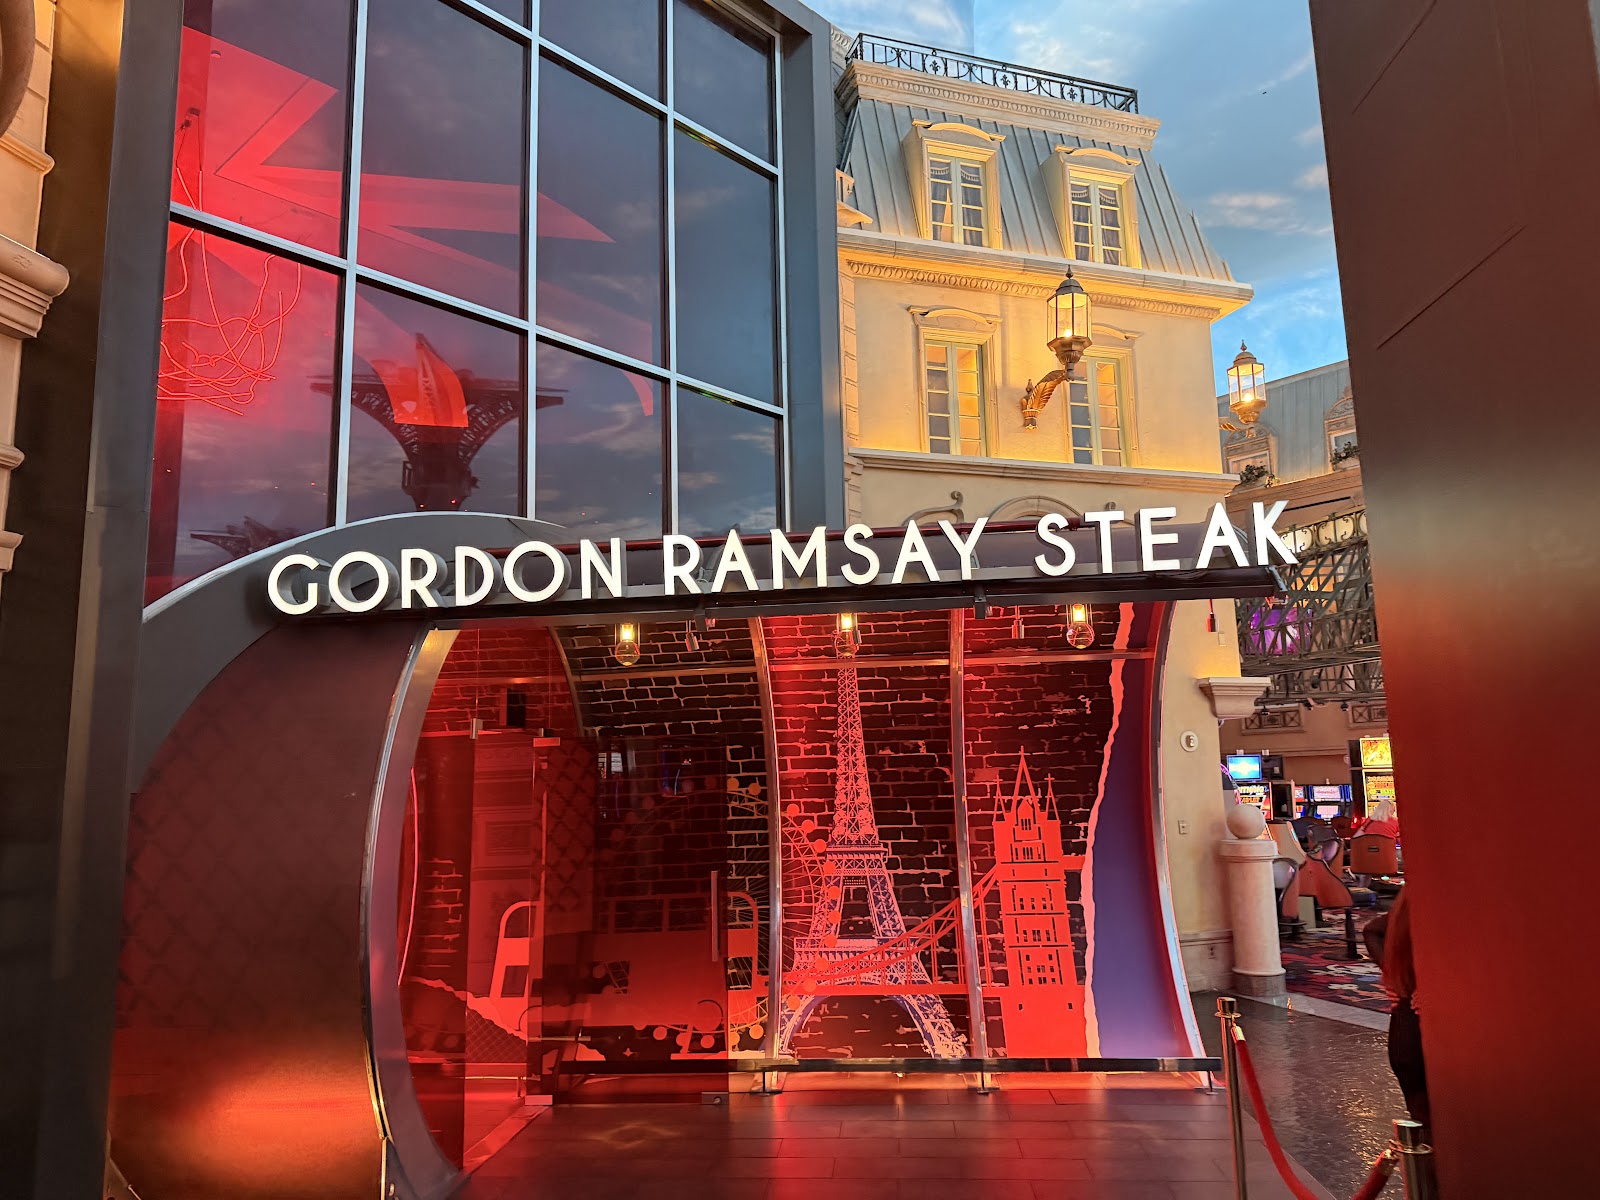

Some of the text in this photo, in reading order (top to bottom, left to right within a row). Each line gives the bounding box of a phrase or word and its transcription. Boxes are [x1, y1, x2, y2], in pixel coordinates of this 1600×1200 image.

[267, 500, 1299, 615] GORDON RAMSAY STEAK
